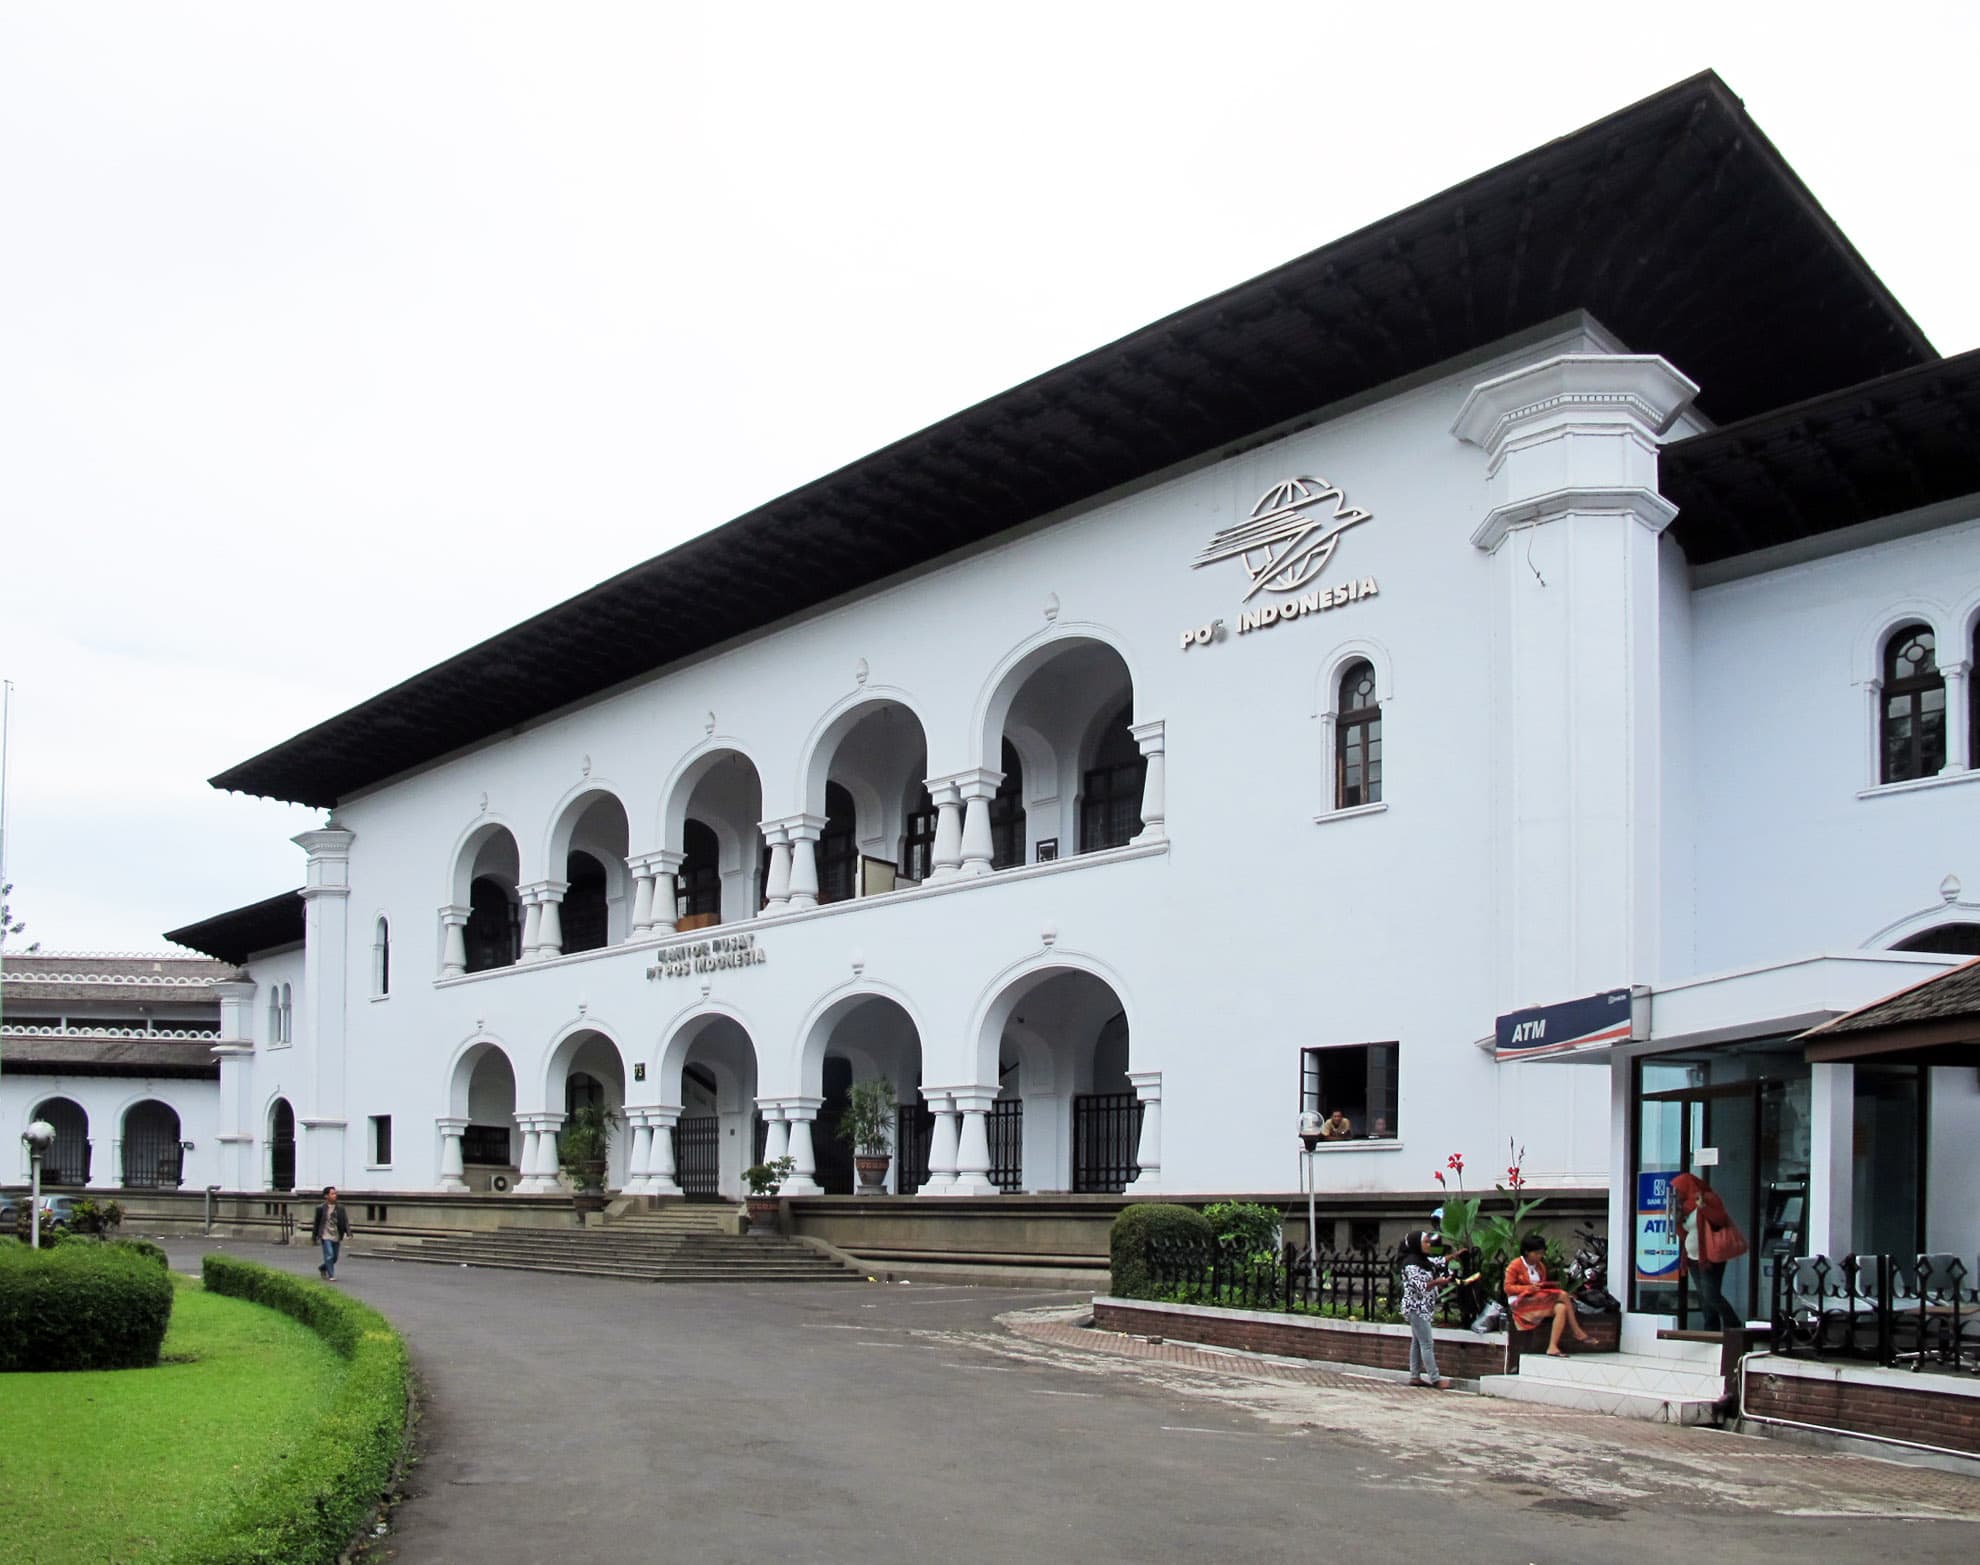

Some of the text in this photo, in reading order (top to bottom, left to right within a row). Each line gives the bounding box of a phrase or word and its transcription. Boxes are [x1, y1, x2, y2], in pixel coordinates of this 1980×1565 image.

[1235, 575, 1379, 633] INDONESIA
[658, 934, 755, 962] KANTOR PUSAT
[664, 961, 690, 977] POS
[695, 948, 767, 974] INDONESIA
[1511, 1019, 1546, 1043] ATM
